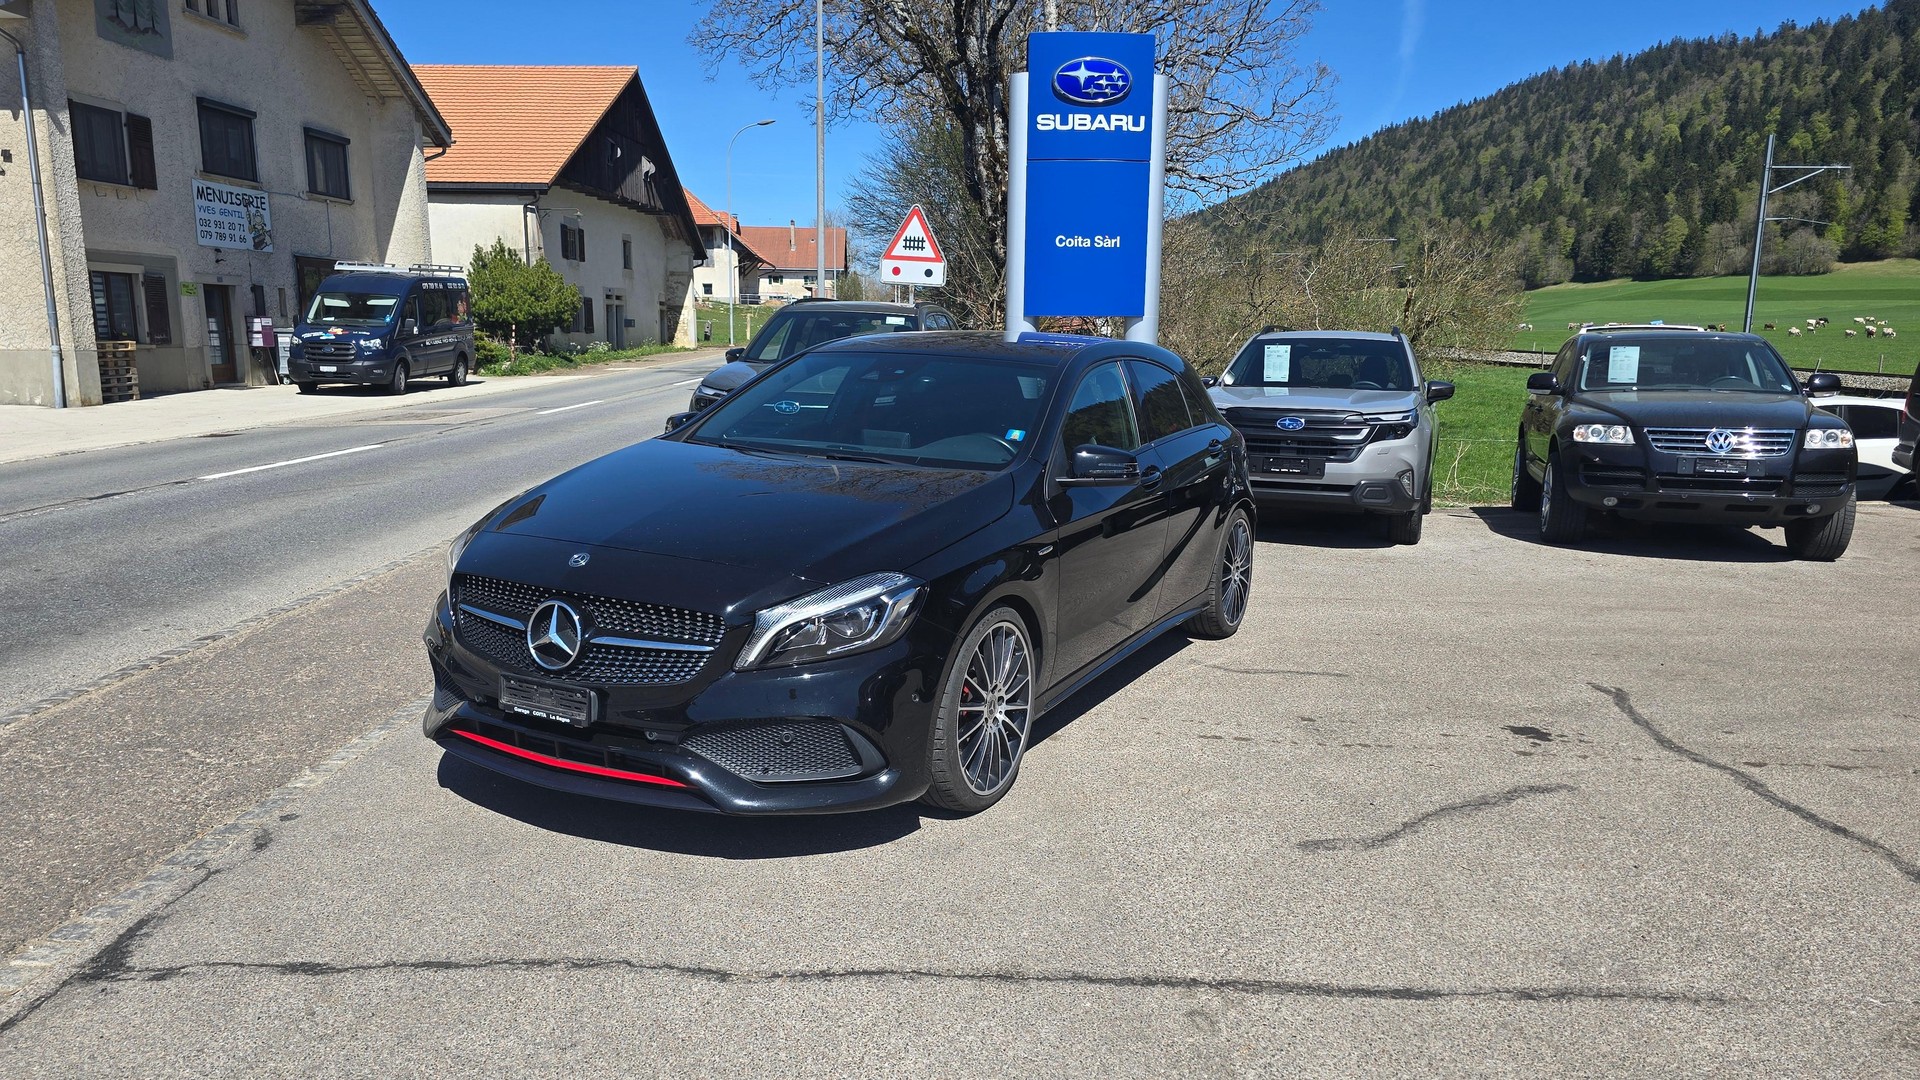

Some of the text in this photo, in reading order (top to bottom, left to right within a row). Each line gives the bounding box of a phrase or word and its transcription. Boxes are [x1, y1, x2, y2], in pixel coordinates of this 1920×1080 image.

[1036, 113, 1146, 132] SUBARU
[197, 186, 266, 210] MENUISERIE
[198, 205, 244, 219] YVES GENTIL
[199, 218, 245, 232] 032 931 20 71
[201, 230, 246, 243] 079 789 91 66
[1055, 235, 1121, 248] Coita Sàrl
[1708, 429, 1733, 452] VW
[514, 706, 529, 714] Garage
